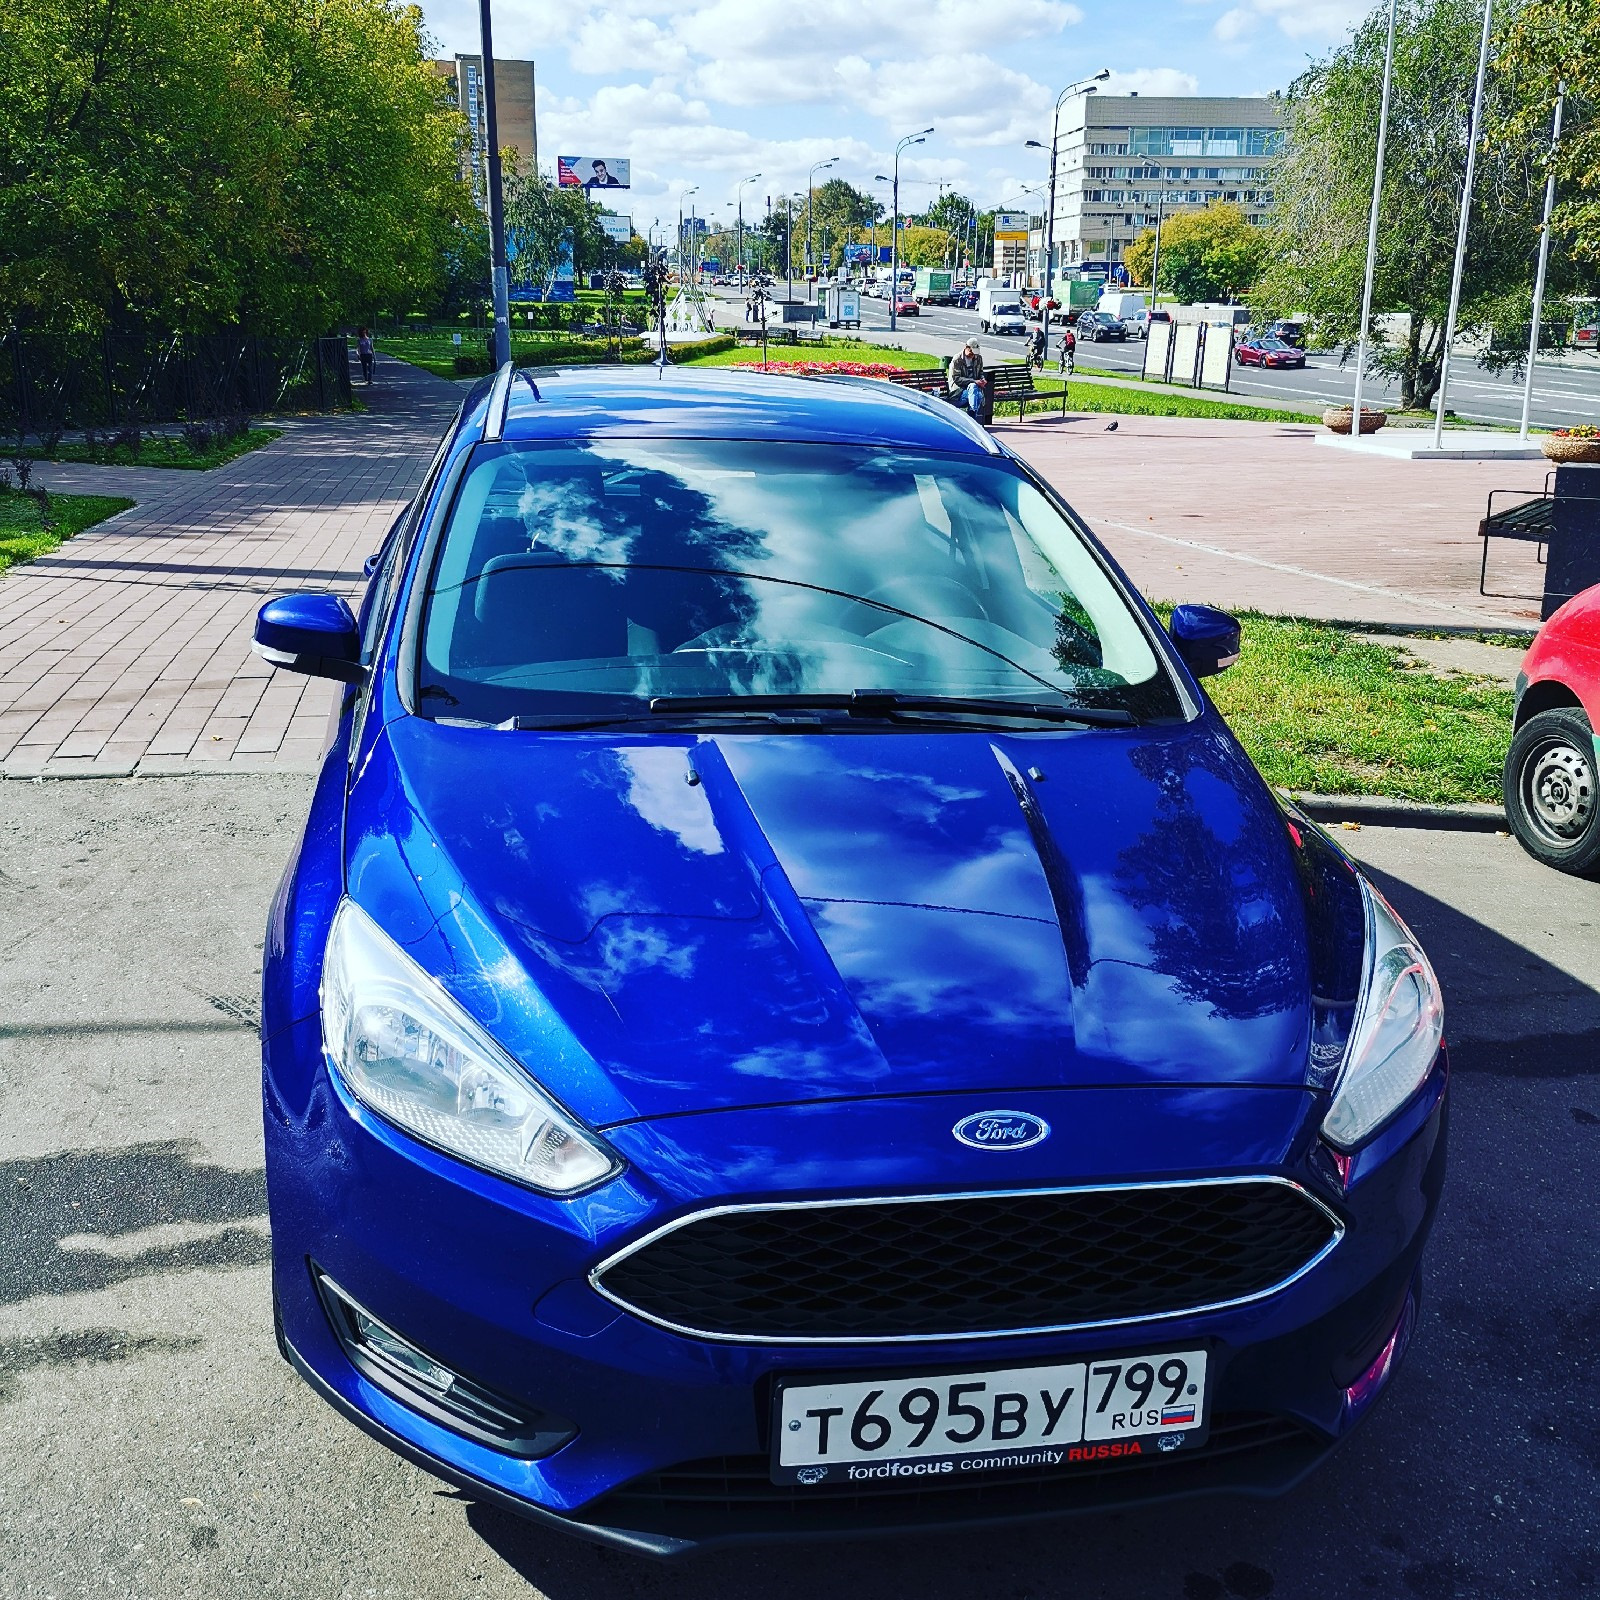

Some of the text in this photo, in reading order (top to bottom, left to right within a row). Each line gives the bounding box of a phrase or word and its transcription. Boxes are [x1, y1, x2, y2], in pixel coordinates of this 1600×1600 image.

[975, 1118, 1027, 1141] Ford
[1092, 1358, 1188, 1414] 799
[1111, 1409, 1160, 1431] RUS
[847, 1441, 1142, 1480] fordfocus community RUSSIA
